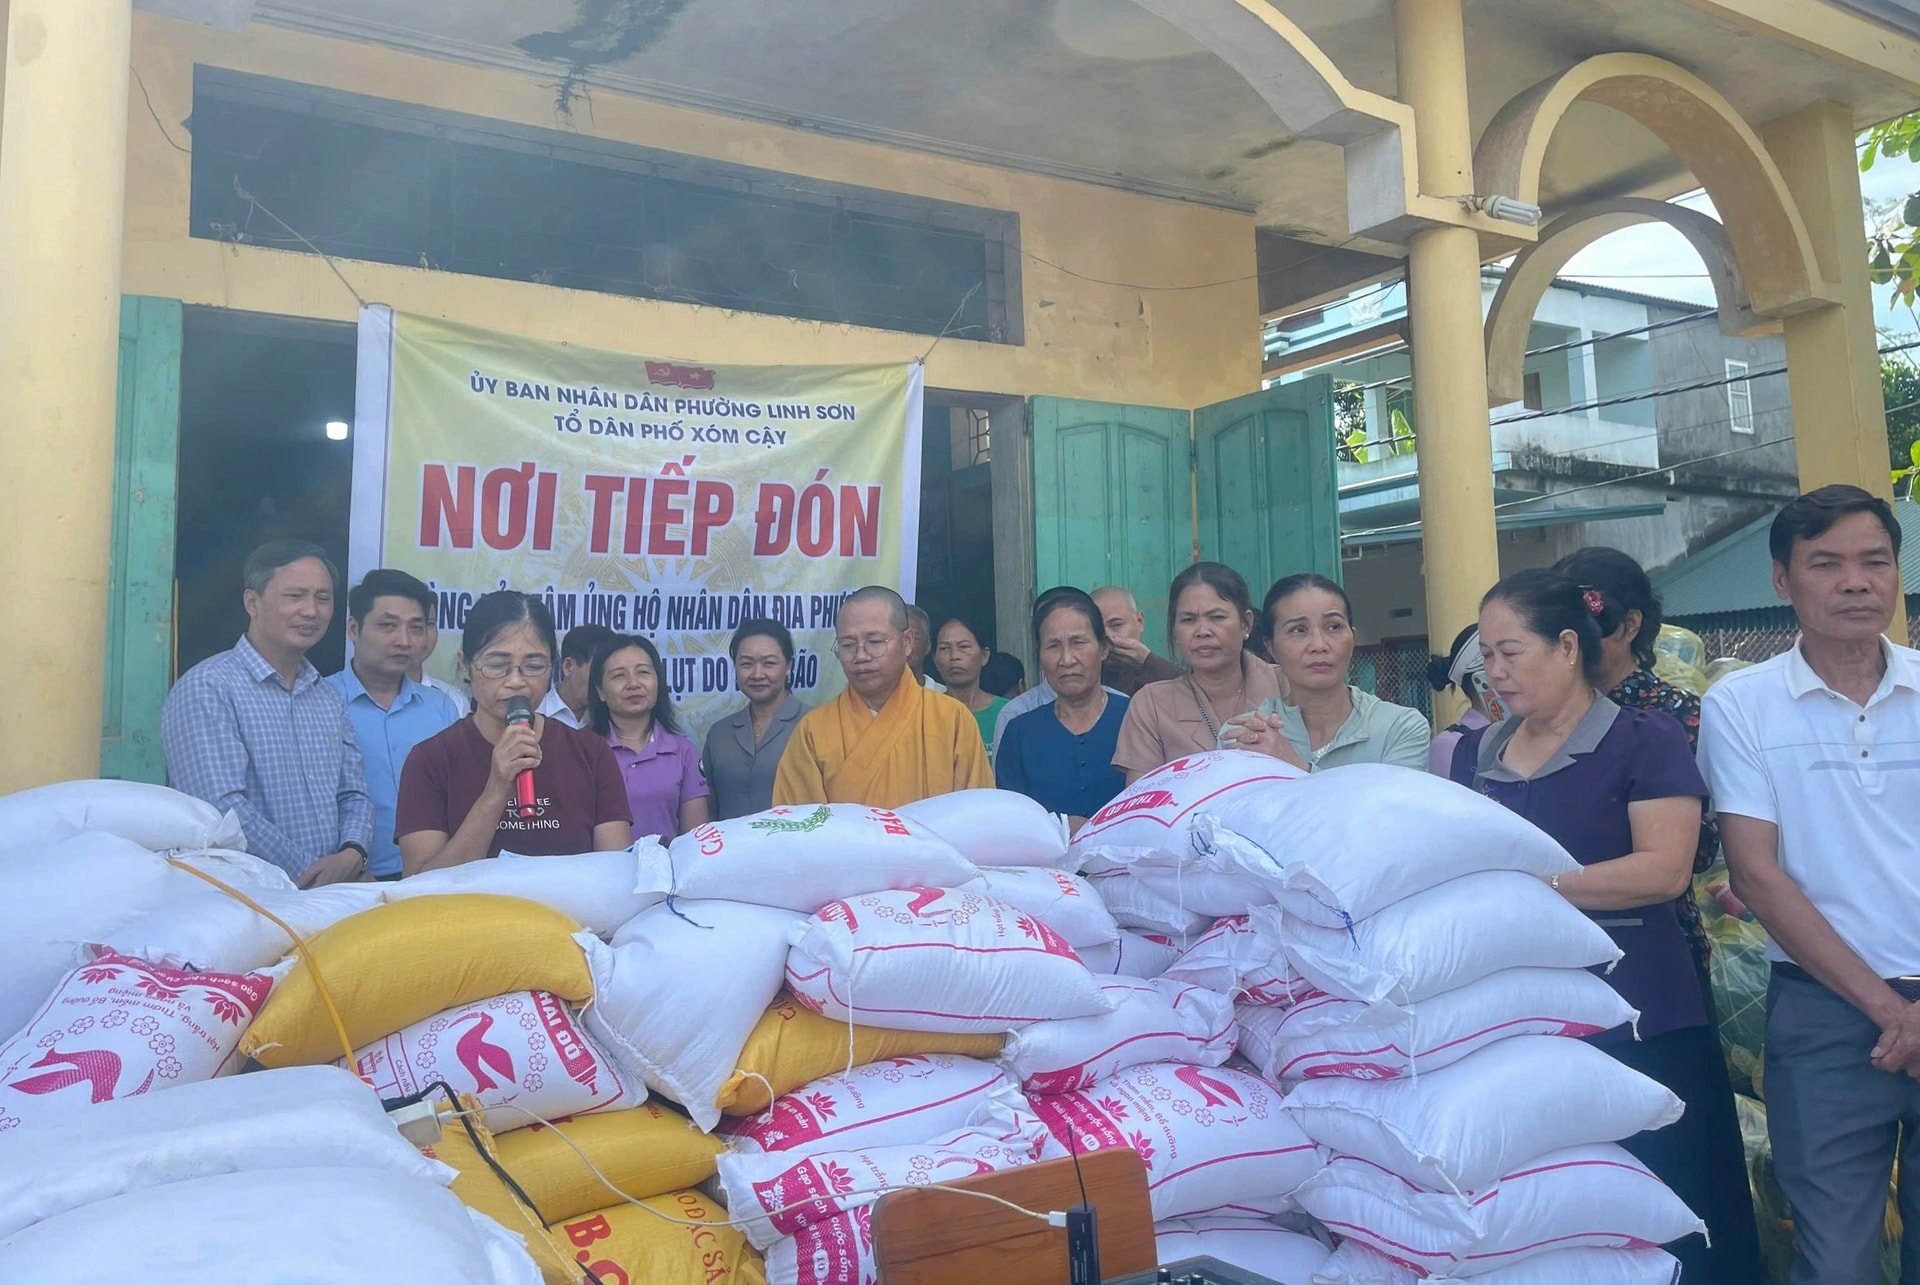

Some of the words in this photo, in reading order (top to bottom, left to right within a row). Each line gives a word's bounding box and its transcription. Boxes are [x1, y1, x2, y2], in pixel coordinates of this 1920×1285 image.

[471, 370, 498, 394] ỦY
[506, 380, 550, 401] BAN
[557, 386, 617, 409] NHÂN
[624, 391, 667, 413] DÂN
[675, 397, 761, 418] PHƯỜNG
[768, 404, 810, 419] LINH
[816, 403, 855, 420] SƠN
[554, 409, 582, 433] TỔ
[589, 416, 634, 438] DÂN
[641, 420, 684, 440] PHỐ
[691, 424, 739, 444] XÓM
[745, 426, 786, 449] CẬY
[419, 462, 558, 551] NƠI
[585, 455, 734, 557] TIẾP
[754, 468, 881, 558] ĐÓN
[583, 581, 627, 630] ỦNG
[632, 588, 662, 638] HỘ
[666, 588, 722, 630] NHÂN
[727, 587, 767, 629] DÂN
[702, 657, 729, 692] DO
[496, 819, 560, 830] OMETHING
[177, 1001, 191, 1013] và
[241, 984, 258, 1001] Gạo
[537, 991, 562, 1027] HÁI
[556, 1029, 584, 1060] ĐỎ
[206, 1036, 220, 1053] Hạt
[1074, 1101, 1088, 1113] cho
[1100, 1127, 1117, 1145] sống
[1085, 1137, 1096, 1147] 10
[797, 1166, 812, 1185] Gạo
[816, 1256, 826, 1271] 10
[831, 1216, 847, 1246] cuộc
[839, 1248, 853, 1282] sống
